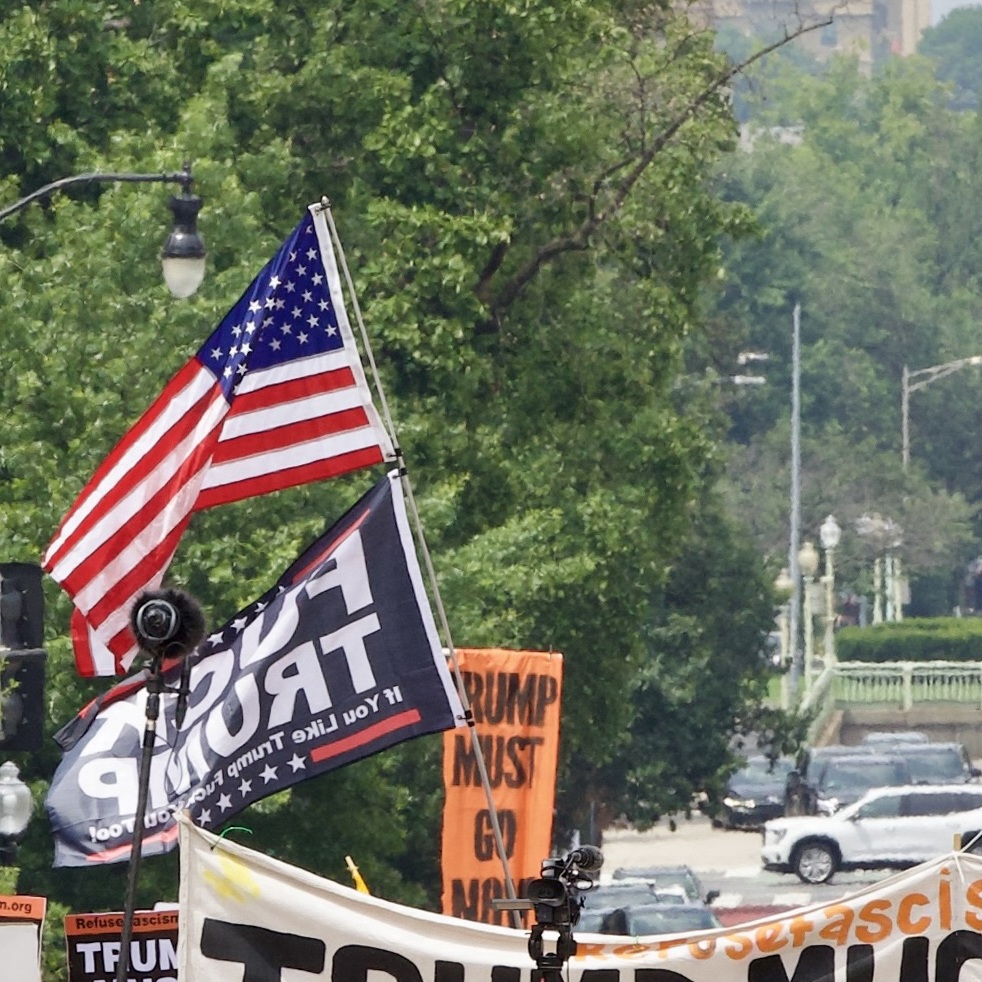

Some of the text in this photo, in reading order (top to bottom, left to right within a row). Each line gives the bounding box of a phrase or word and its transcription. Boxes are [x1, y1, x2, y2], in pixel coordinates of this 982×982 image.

[452, 733, 546, 790] MUST
[474, 808, 518, 863] GO
[76, 938, 179, 974] TRUM
